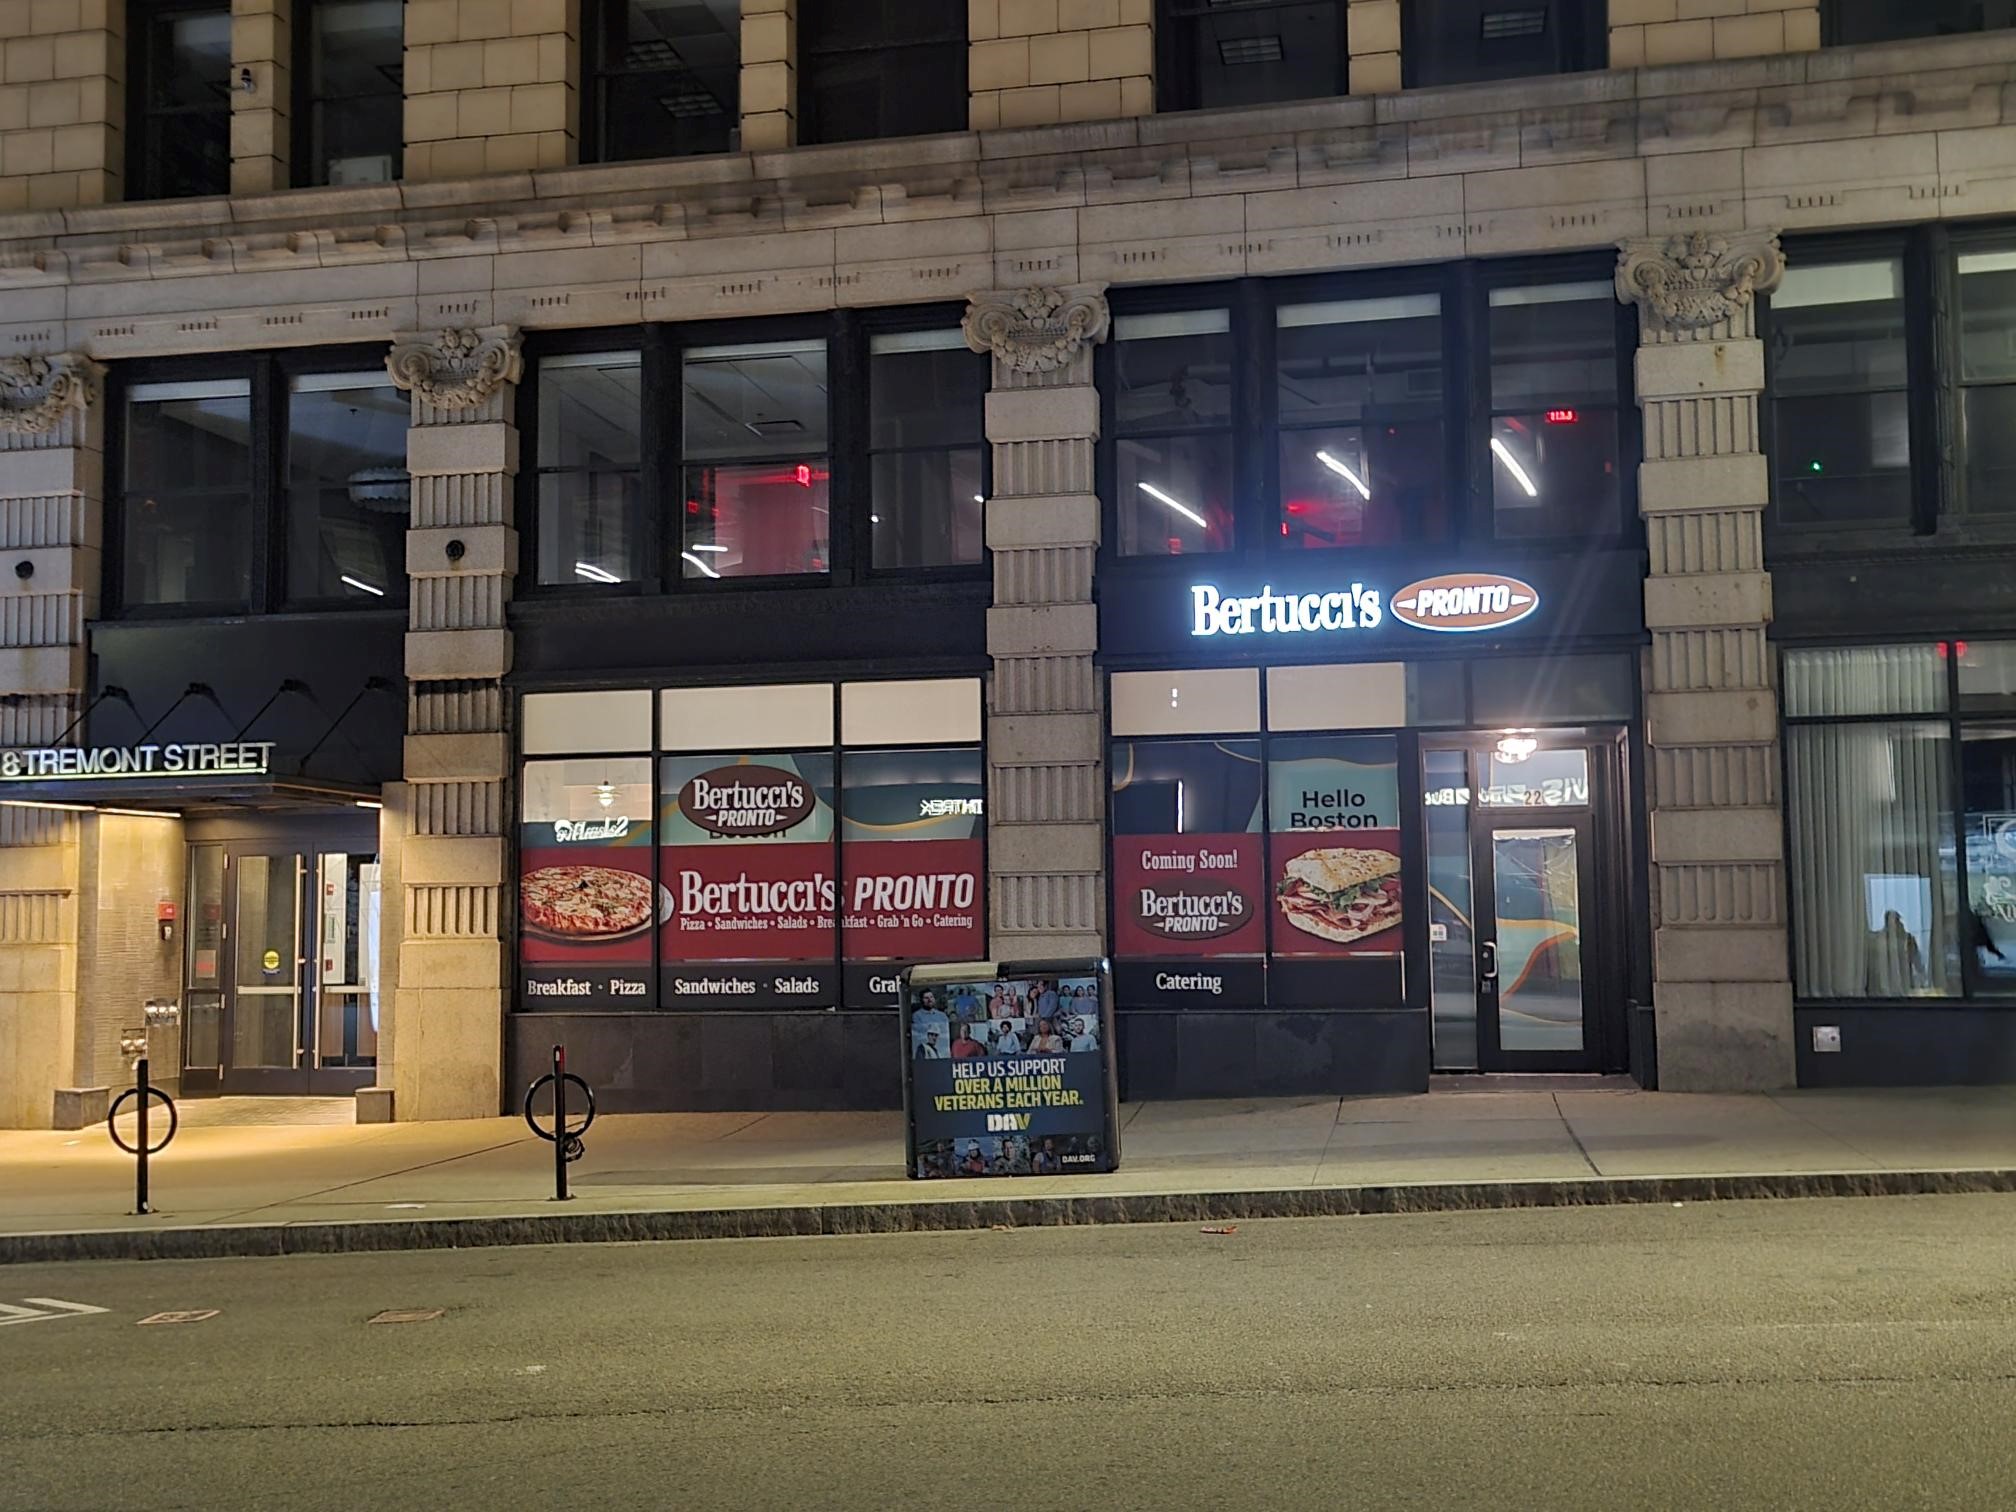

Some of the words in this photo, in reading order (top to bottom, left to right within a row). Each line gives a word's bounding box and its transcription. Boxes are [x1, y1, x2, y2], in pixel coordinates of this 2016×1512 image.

[1190, 583, 1382, 636] Bertucci's
[1416, 585, 1512, 618] PRONTO
[22, 746, 159, 775] TREMONT
[164, 742, 276, 770] STREET
[692, 779, 804, 810] Bertucci's
[1302, 789, 1366, 808] Hello
[1523, 790, 1542, 806] 22
[717, 809, 776, 827] PRONTO
[1291, 812, 1378, 828] Boston
[1141, 850, 1195, 873] Coming
[1200, 849, 1238, 869] Soon!
[679, 870, 846, 914] Bertucci's
[853, 873, 975, 912] PRONTO
[1140, 888, 1243, 917] Bertucci's
[680, 917, 706, 931] Pizza
[714, 916, 768, 930] Sandwiches
[777, 915, 808, 929] Salads
[877, 914, 899, 928] Grab
[911, 915, 924, 927] Go
[933, 914, 973, 929] Catering
[1164, 916, 1218, 933] PRONTO
[527, 979, 592, 996] Breakfast
[609, 979, 647, 996] Pizza
[674, 977, 757, 995] Sandwiches
[774, 976, 820, 994] Salads
[1156, 973, 1222, 995] Catering
[952, 1061, 985, 1079] HELP
[987, 1060, 1006, 1078] US
[1007, 1058, 1067, 1076] SUPPORT
[954, 1077, 991, 1095] OVER
[993, 1076, 1003, 1093] A
[1005, 1075, 1062, 1092] MILLION
[934, 1093, 1004, 1112] VETERANS
[1006, 1092, 1042, 1109] EACH
[1043, 1089, 1084, 1107] YEAR.
[986, 1112, 1033, 1132] DAV
[1061, 1153, 1096, 1164] DAV.ORG
